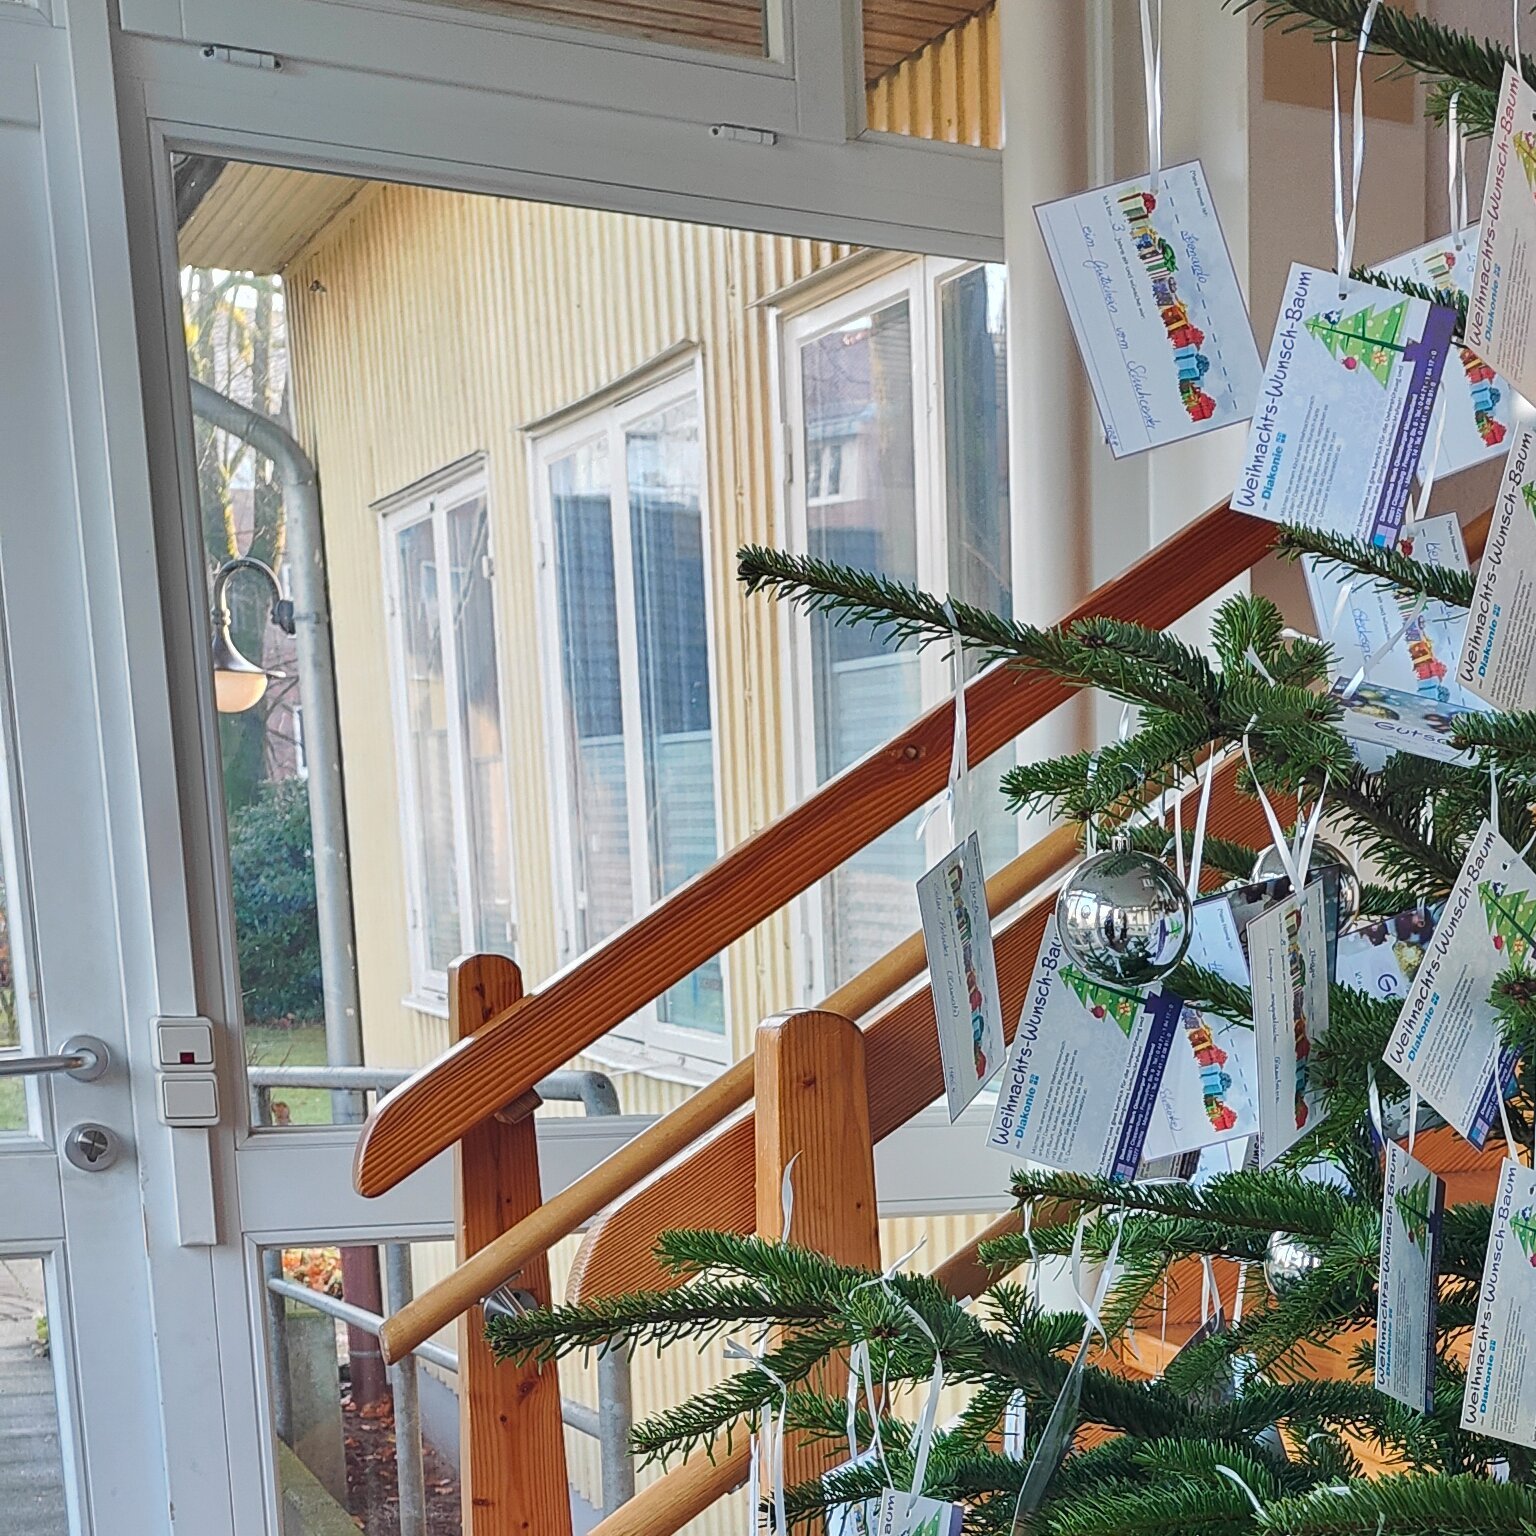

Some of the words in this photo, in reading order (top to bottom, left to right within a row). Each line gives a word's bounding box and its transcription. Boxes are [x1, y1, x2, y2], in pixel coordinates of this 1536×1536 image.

[1468, 76, 1519, 346] Weihnachts-Wunsch-Baum
[1484, 279, 1498, 342] Diakonie
[1236, 271, 1312, 507] Weihnachts-Wunsch-Baum
[1260, 444, 1283, 500] Diakonie
[1459, 432, 1532, 682] Weihnachts-Wunsch-Baum
[1477, 618, 1497, 677] Diakonie
[1389, 831, 1496, 1063] Weihnachts-Wunsch-Baum
[991, 932, 1065, 1144] Weihnachts-Wunsch-Bau
[1407, 1006, 1434, 1061] Diakonie
[1014, 1086, 1036, 1138] Diakonie
[1464, 1167, 1516, 1423] Weihnachts-Wunsch-Baum
[1480, 1354, 1494, 1413] Diakonie
